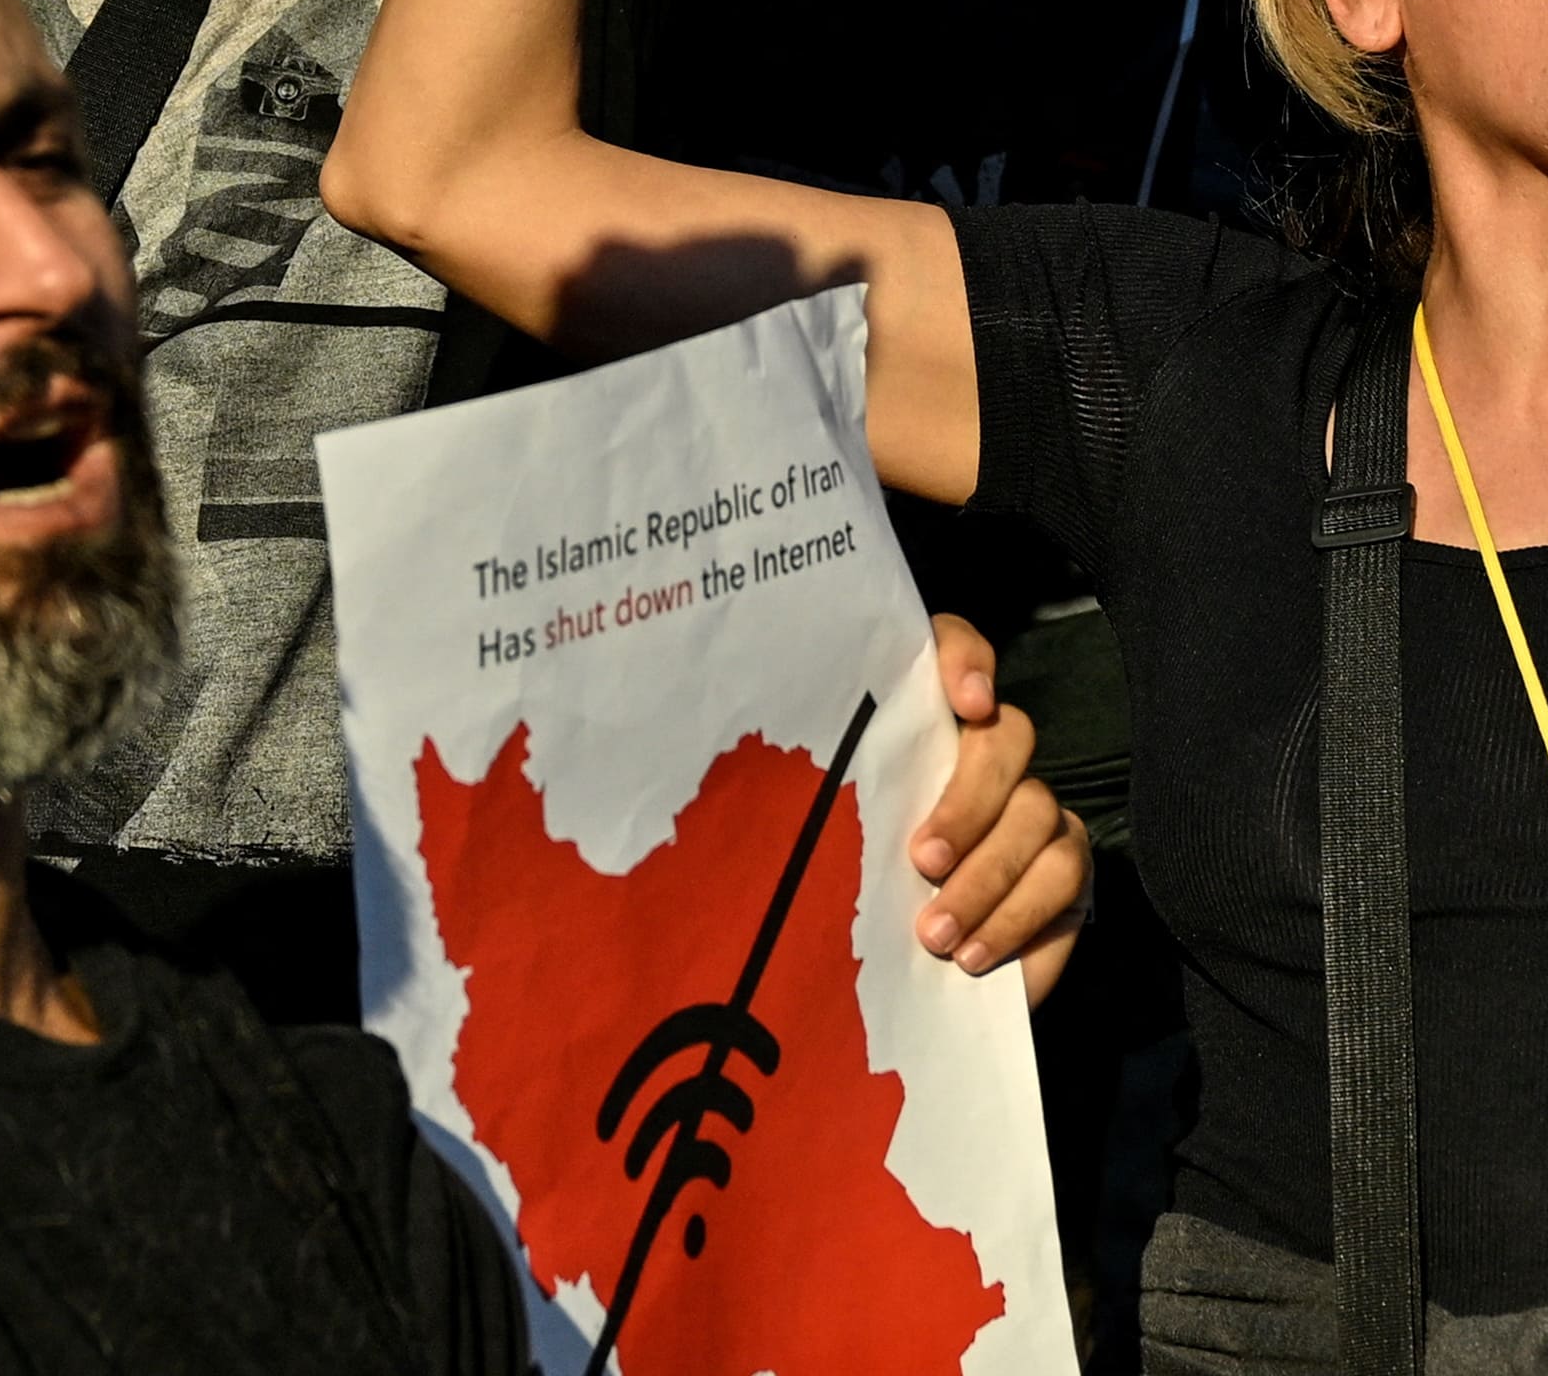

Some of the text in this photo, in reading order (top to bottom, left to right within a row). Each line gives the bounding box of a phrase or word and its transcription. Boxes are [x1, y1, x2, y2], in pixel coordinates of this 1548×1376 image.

[473, 459, 845, 598] The Islamic Republic of Iran
[479, 521, 856, 668] Has shut down the Internet
